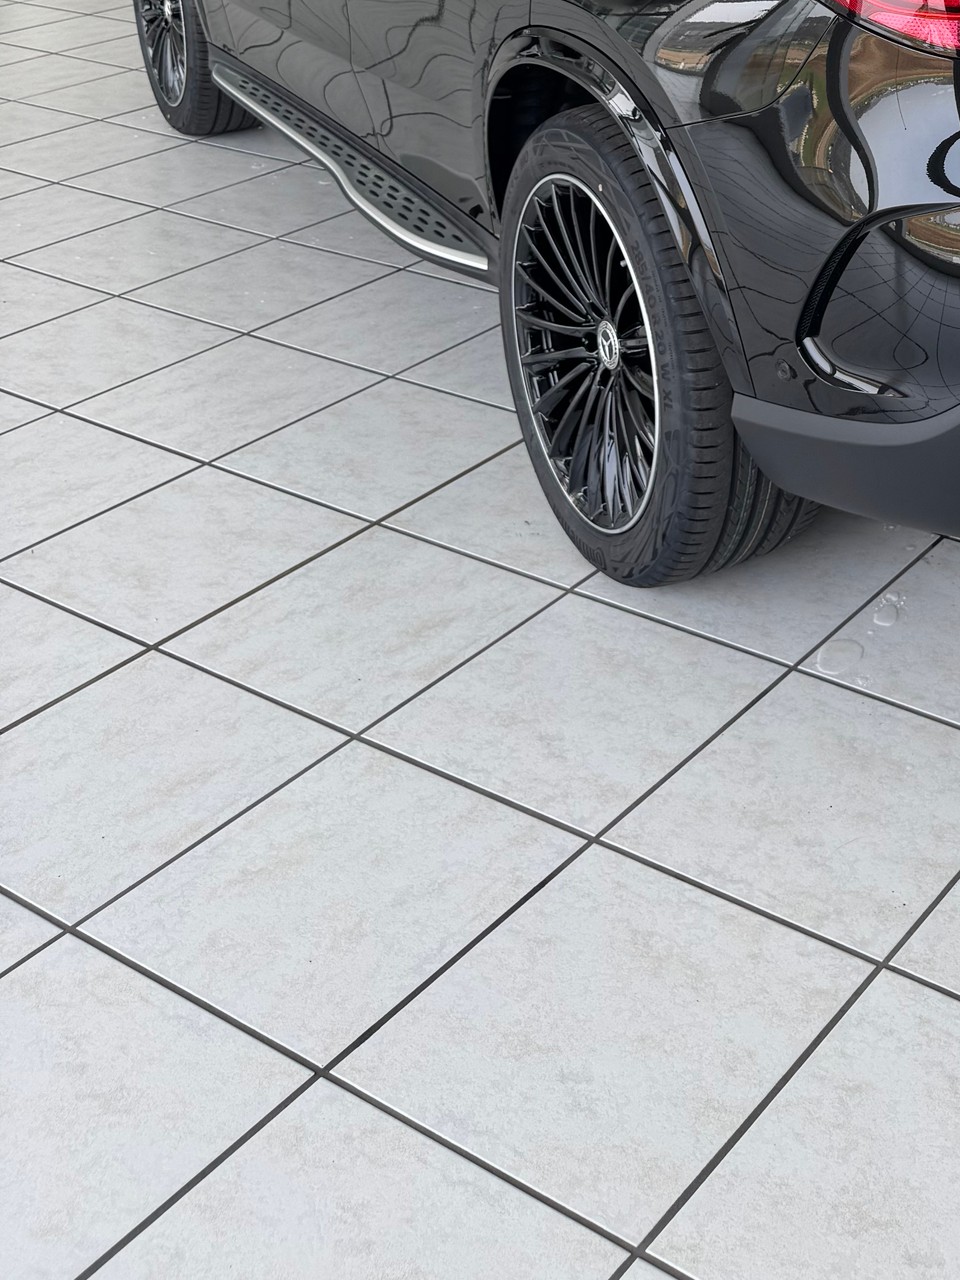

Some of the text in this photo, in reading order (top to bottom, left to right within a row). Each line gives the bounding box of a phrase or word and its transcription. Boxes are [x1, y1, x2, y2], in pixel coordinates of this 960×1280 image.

[630, 240, 657, 309] 285/40
[651, 313, 660, 328] R
[655, 329, 667, 356] 20
[660, 362, 671, 382] W
[662, 388, 673, 412] XL
